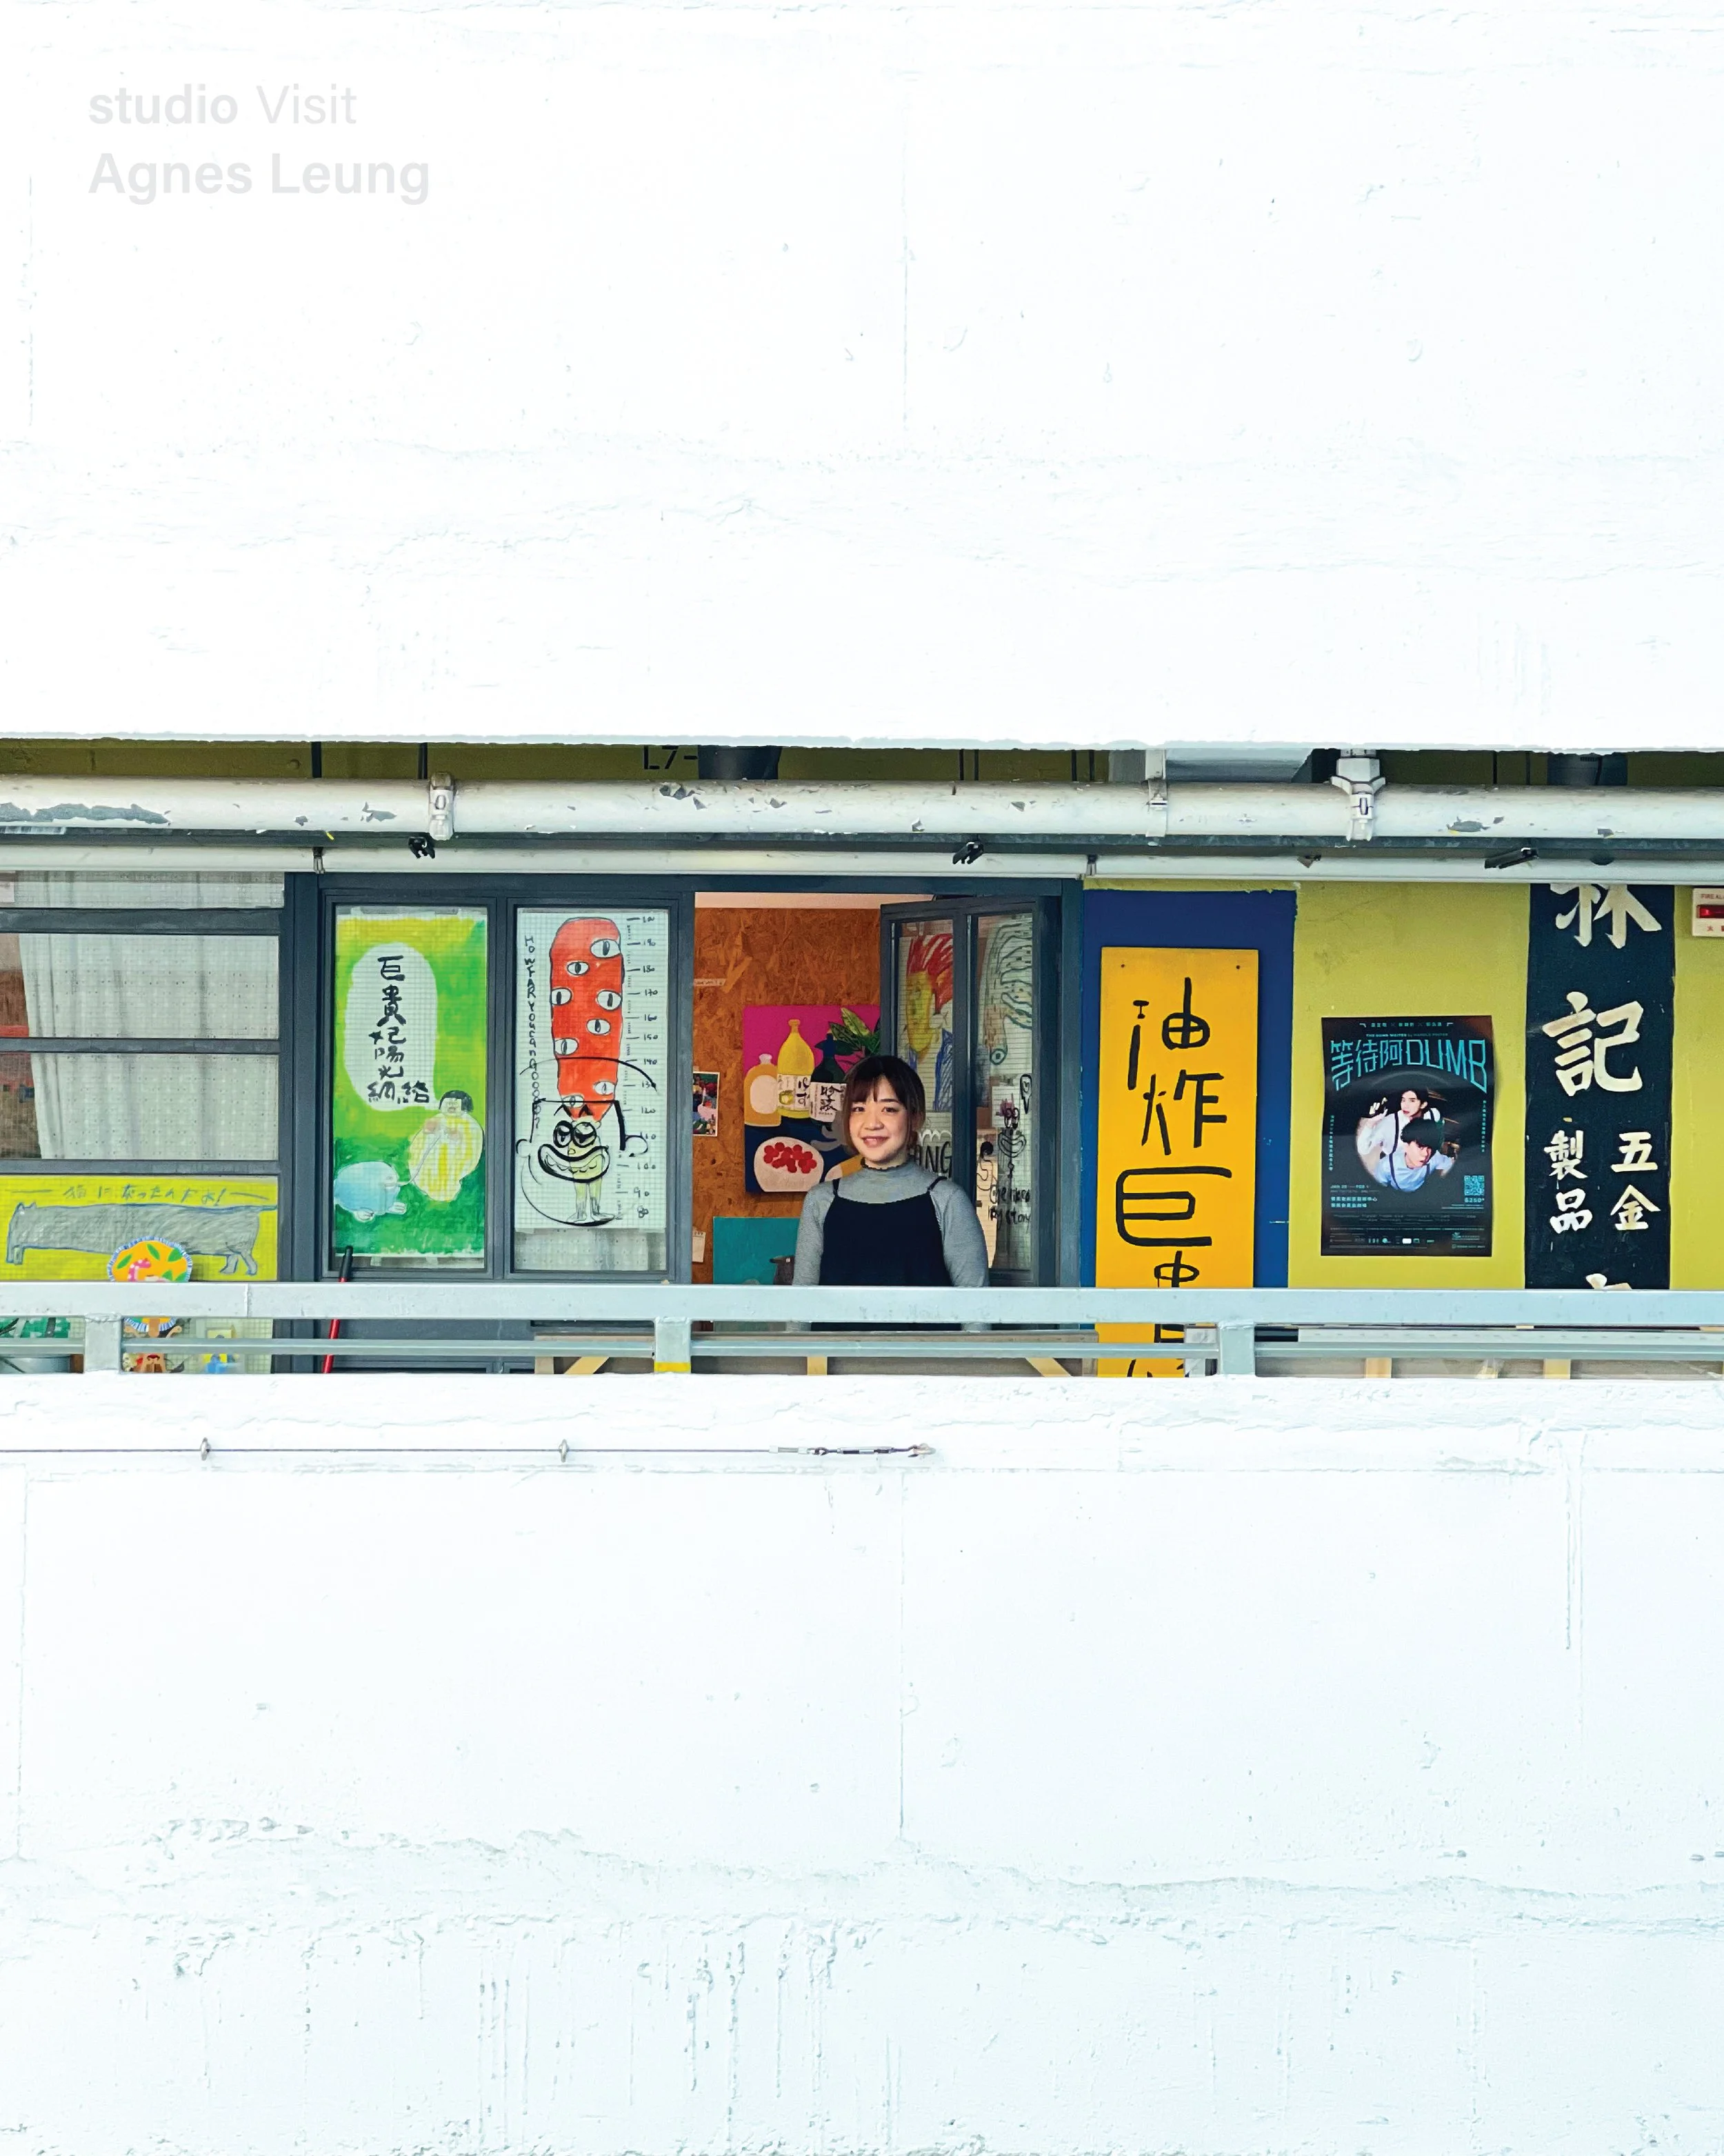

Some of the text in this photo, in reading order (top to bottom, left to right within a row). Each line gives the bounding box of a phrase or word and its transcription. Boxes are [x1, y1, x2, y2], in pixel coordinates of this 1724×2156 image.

[645, 988, 659, 997] 170
[634, 1187, 650, 1198] 90
[1543, 1130, 1593, 1234] 製品
[1610, 1132, 1661, 1231] 五金
